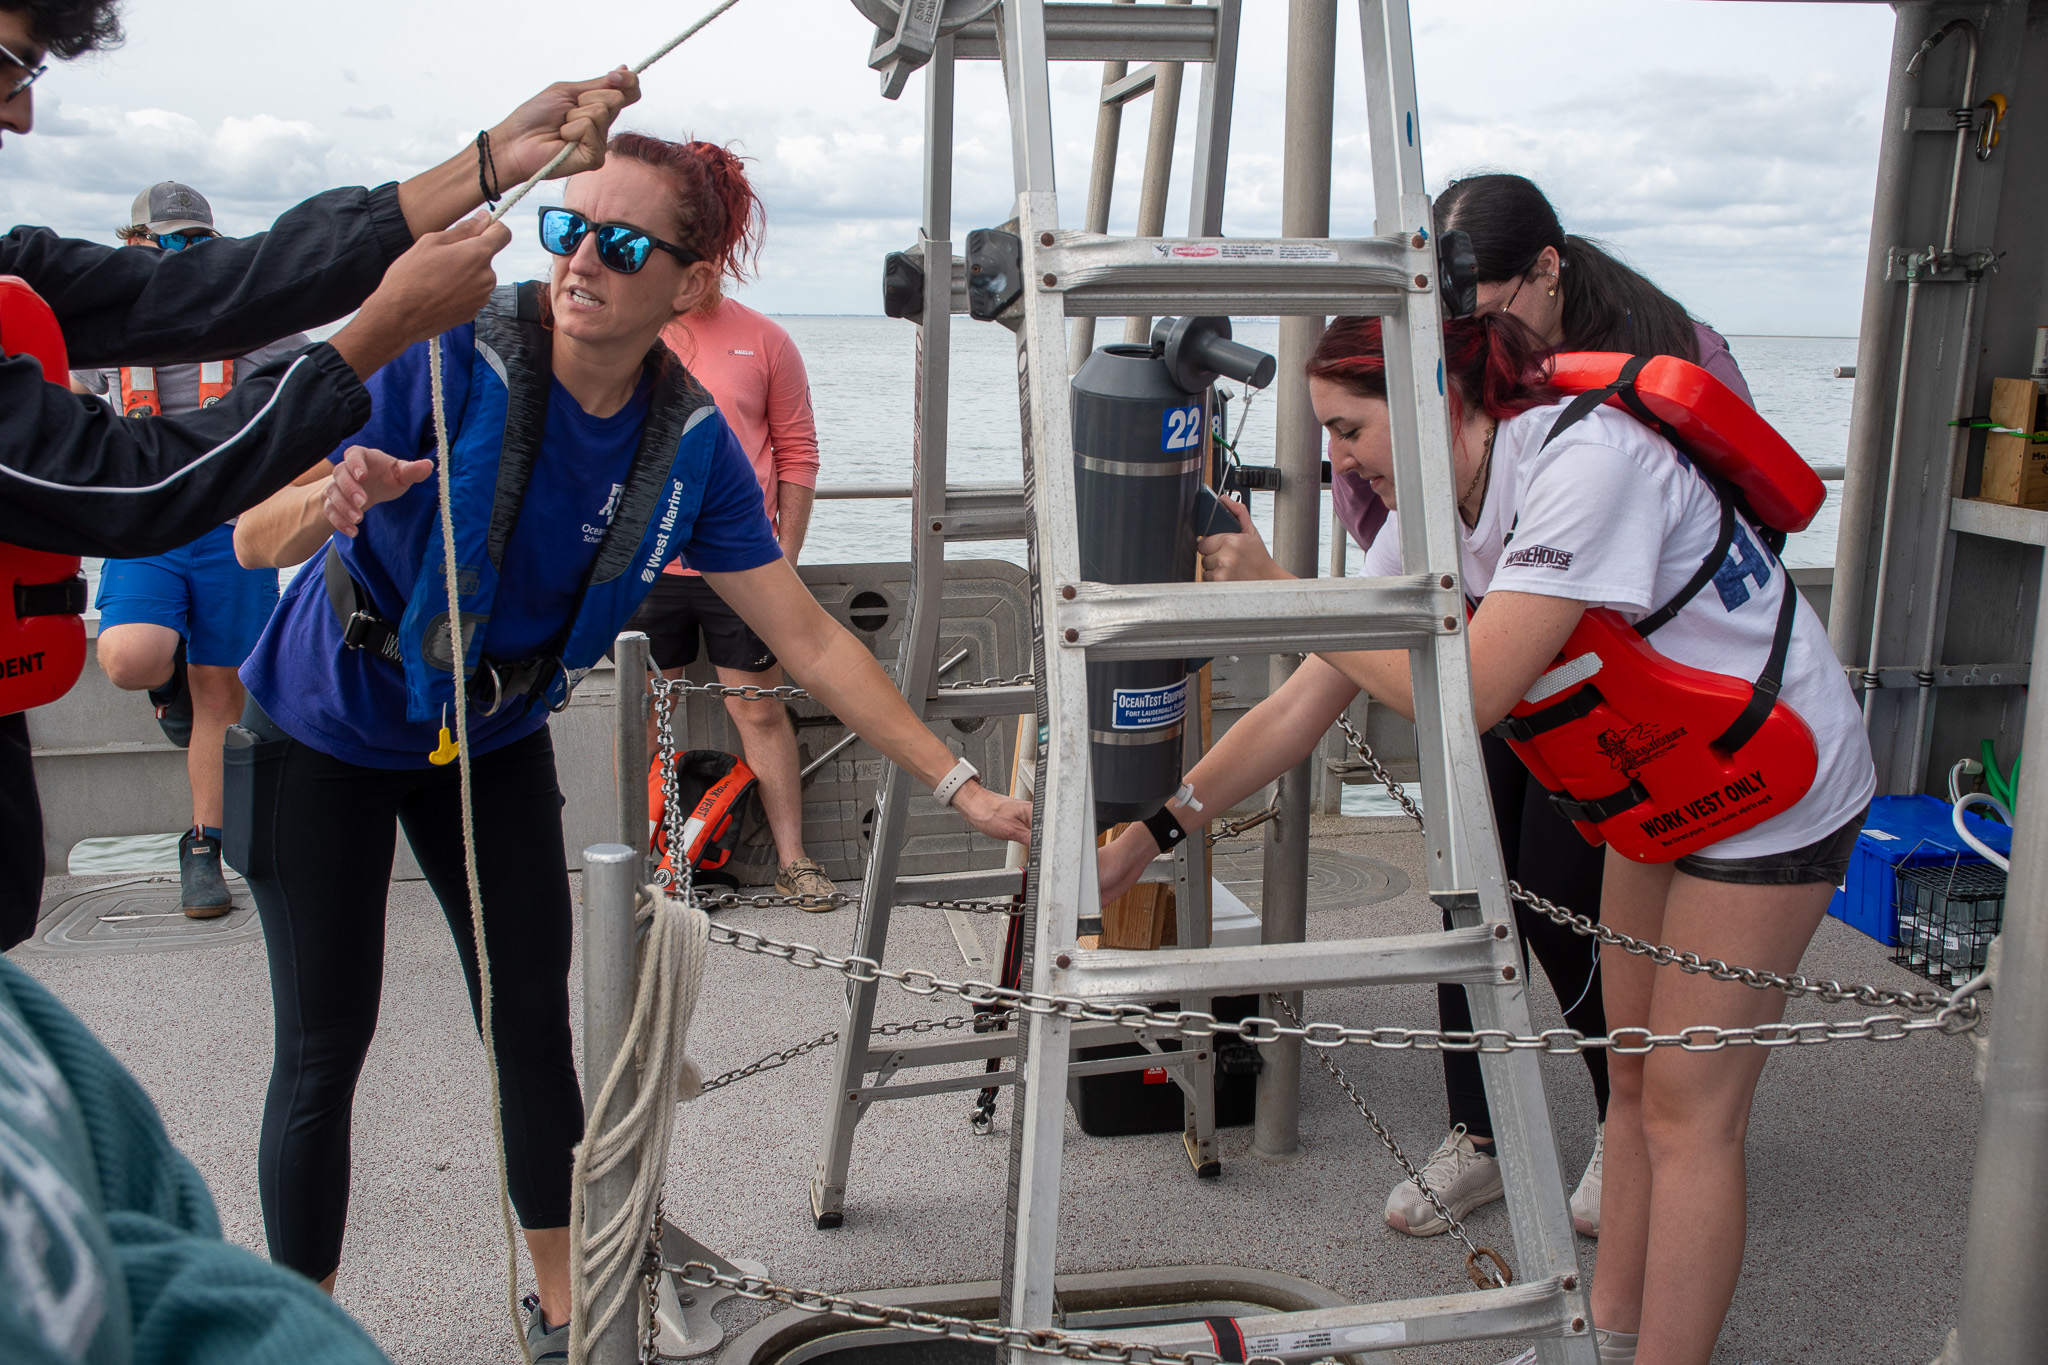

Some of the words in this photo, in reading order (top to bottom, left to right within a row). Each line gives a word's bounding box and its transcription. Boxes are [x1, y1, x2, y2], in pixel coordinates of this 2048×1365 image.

[1166, 407, 1200, 450] 22
[646, 533, 670, 568] West
[659, 480, 684, 532] Marine
[1505, 546, 1573, 567] WAREHOUSE
[696, 797, 717, 818] VEST
[1639, 808, 1690, 839] WORK
[1683, 790, 1726, 820] VEST
[1724, 770, 1768, 802] ONLY
